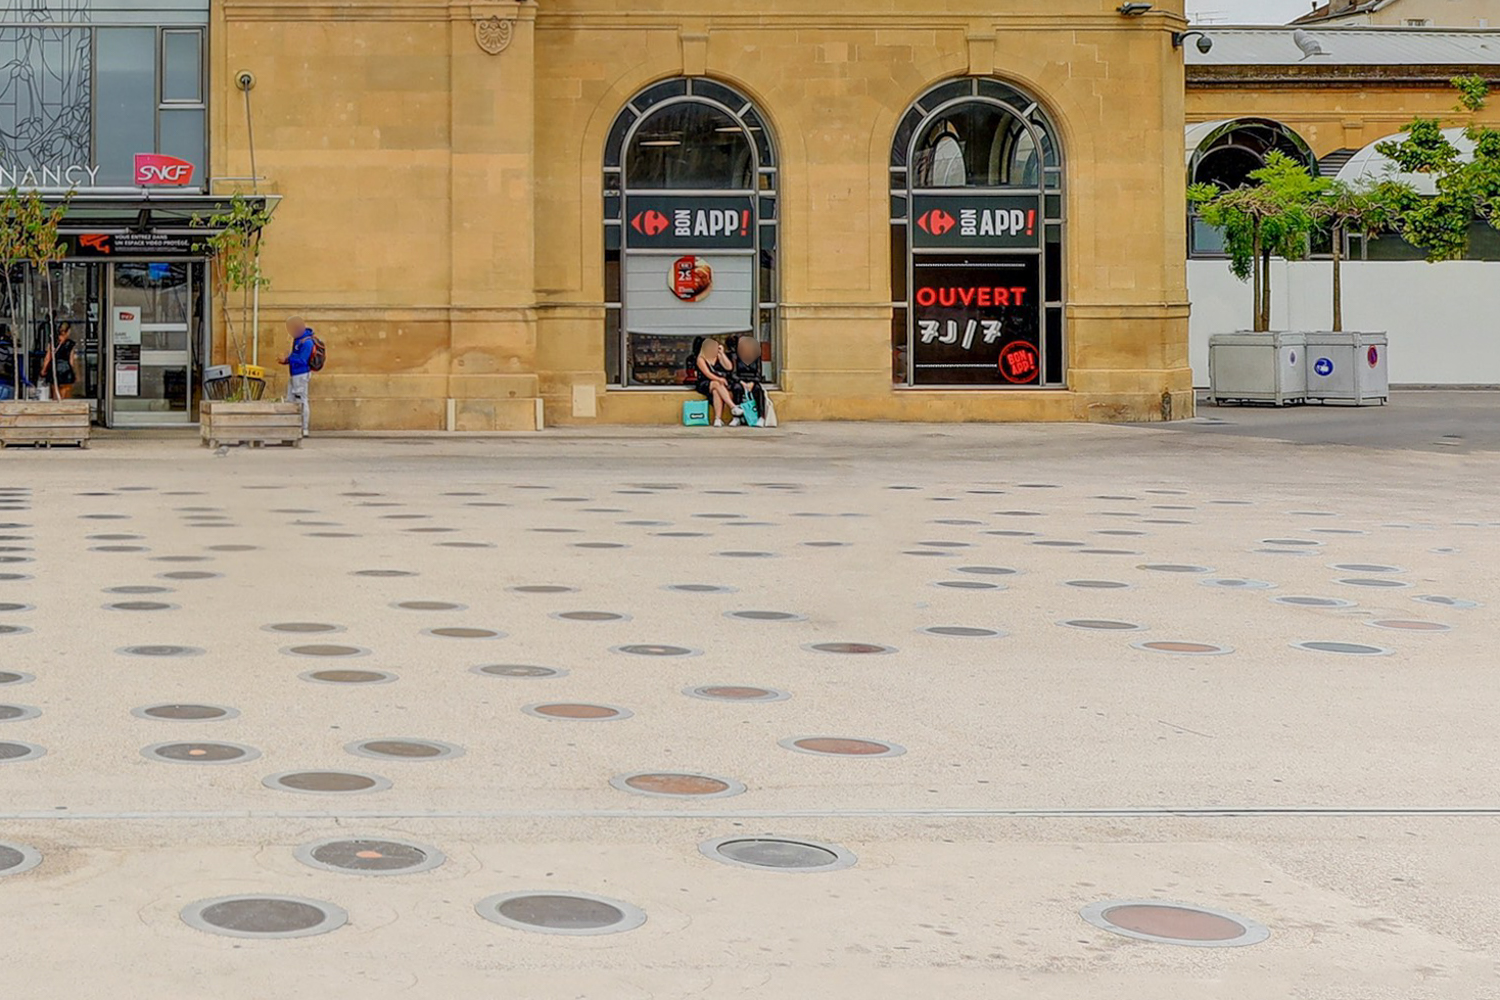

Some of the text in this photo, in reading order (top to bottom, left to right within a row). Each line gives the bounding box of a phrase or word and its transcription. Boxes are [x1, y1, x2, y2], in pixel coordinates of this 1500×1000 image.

[137, 165, 190, 181] SNCF
[674, 209, 749, 236] BON APP!
[960, 209, 1036, 236] BON APP!
[916, 287, 1027, 306] OUVERT
[1007, 350, 1027, 366] BON
